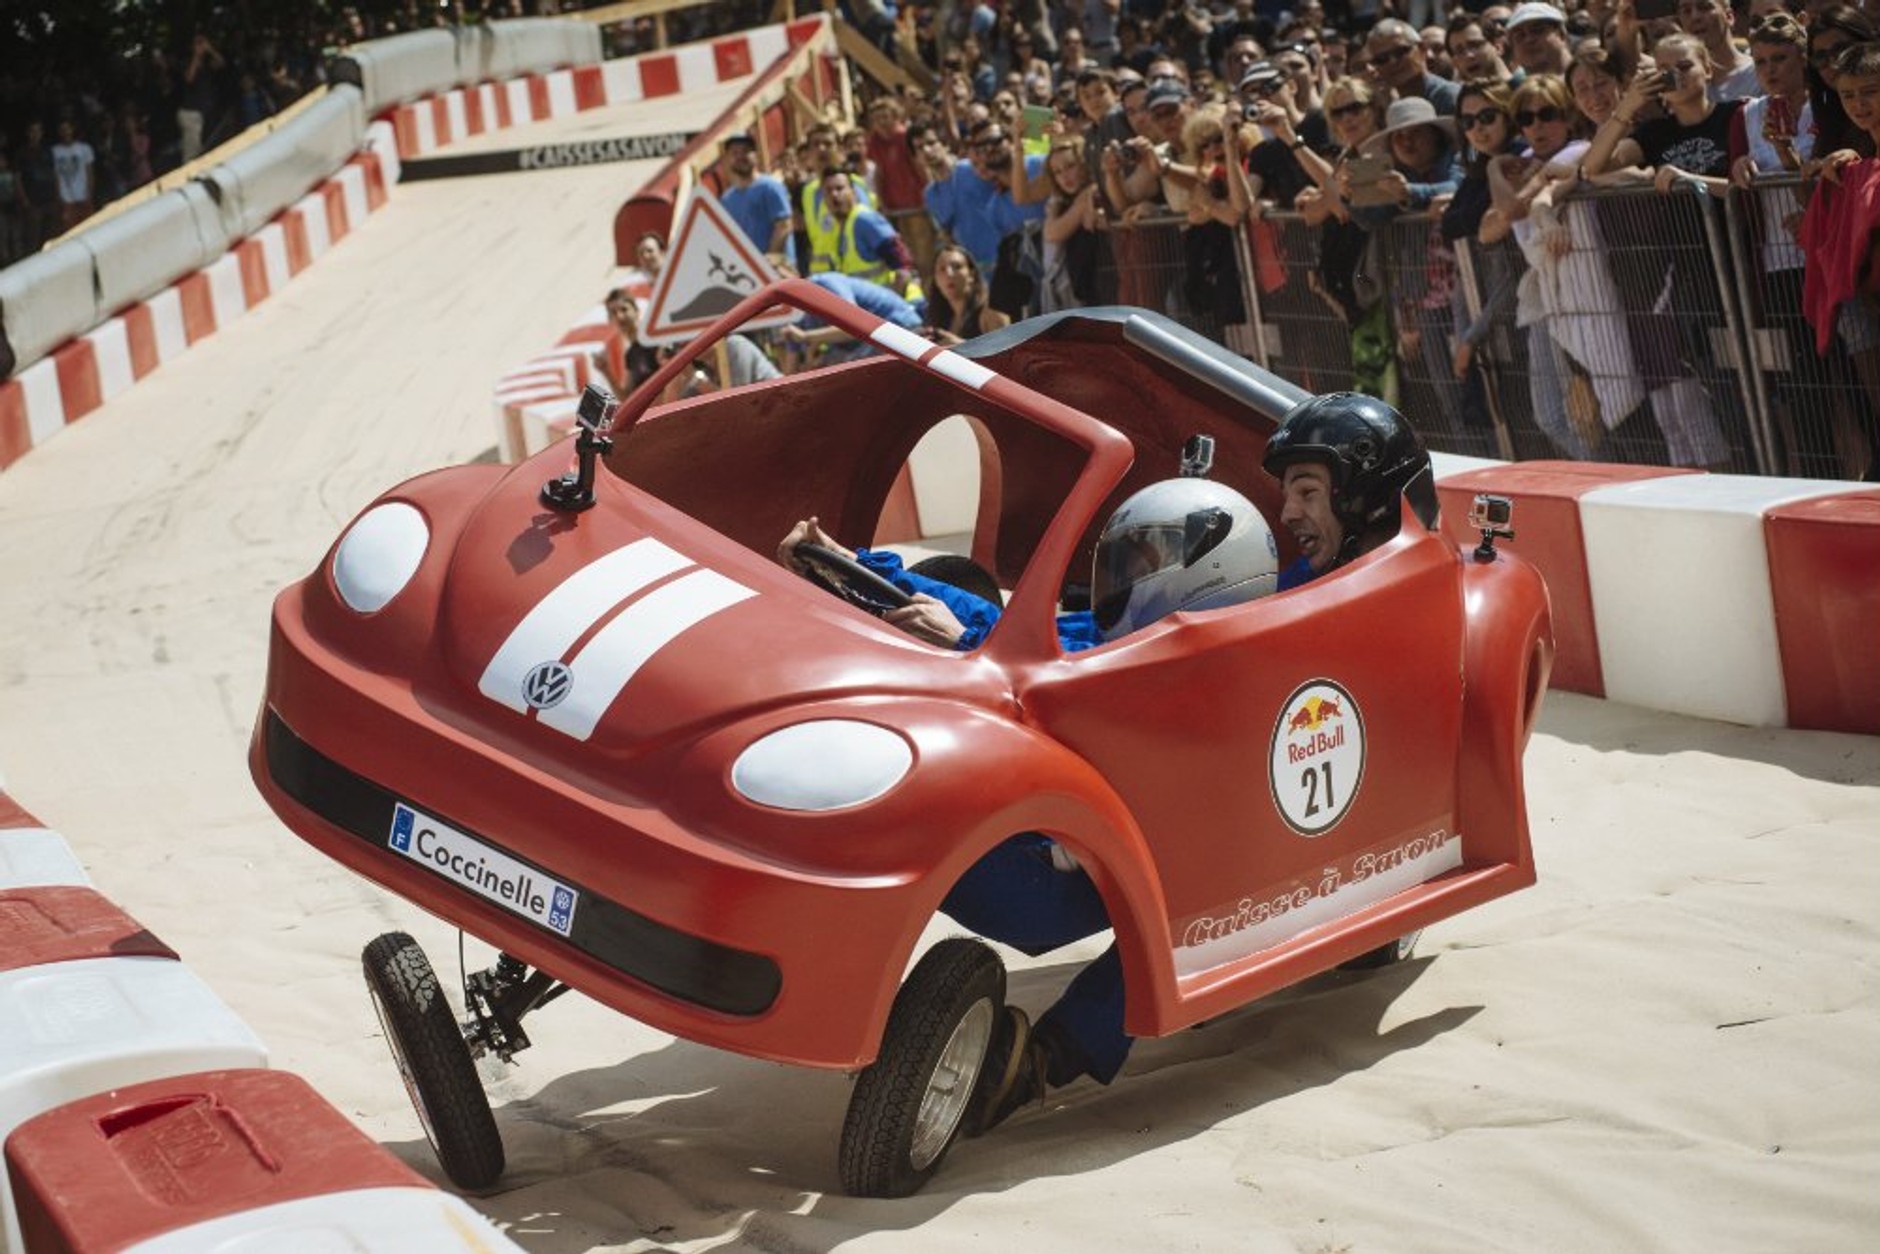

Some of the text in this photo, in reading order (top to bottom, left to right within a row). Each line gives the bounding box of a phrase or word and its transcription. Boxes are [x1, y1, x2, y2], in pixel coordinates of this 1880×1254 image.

[519, 133, 687, 169] #CAISSESASAVON
[1287, 724, 1345, 765] Red Bull
[1301, 761, 1335, 818] 21
[396, 832, 406, 846] F
[1352, 829, 1447, 885] Savon
[416, 829, 546, 915] Coccinelle
[550, 910, 568, 931] 53
